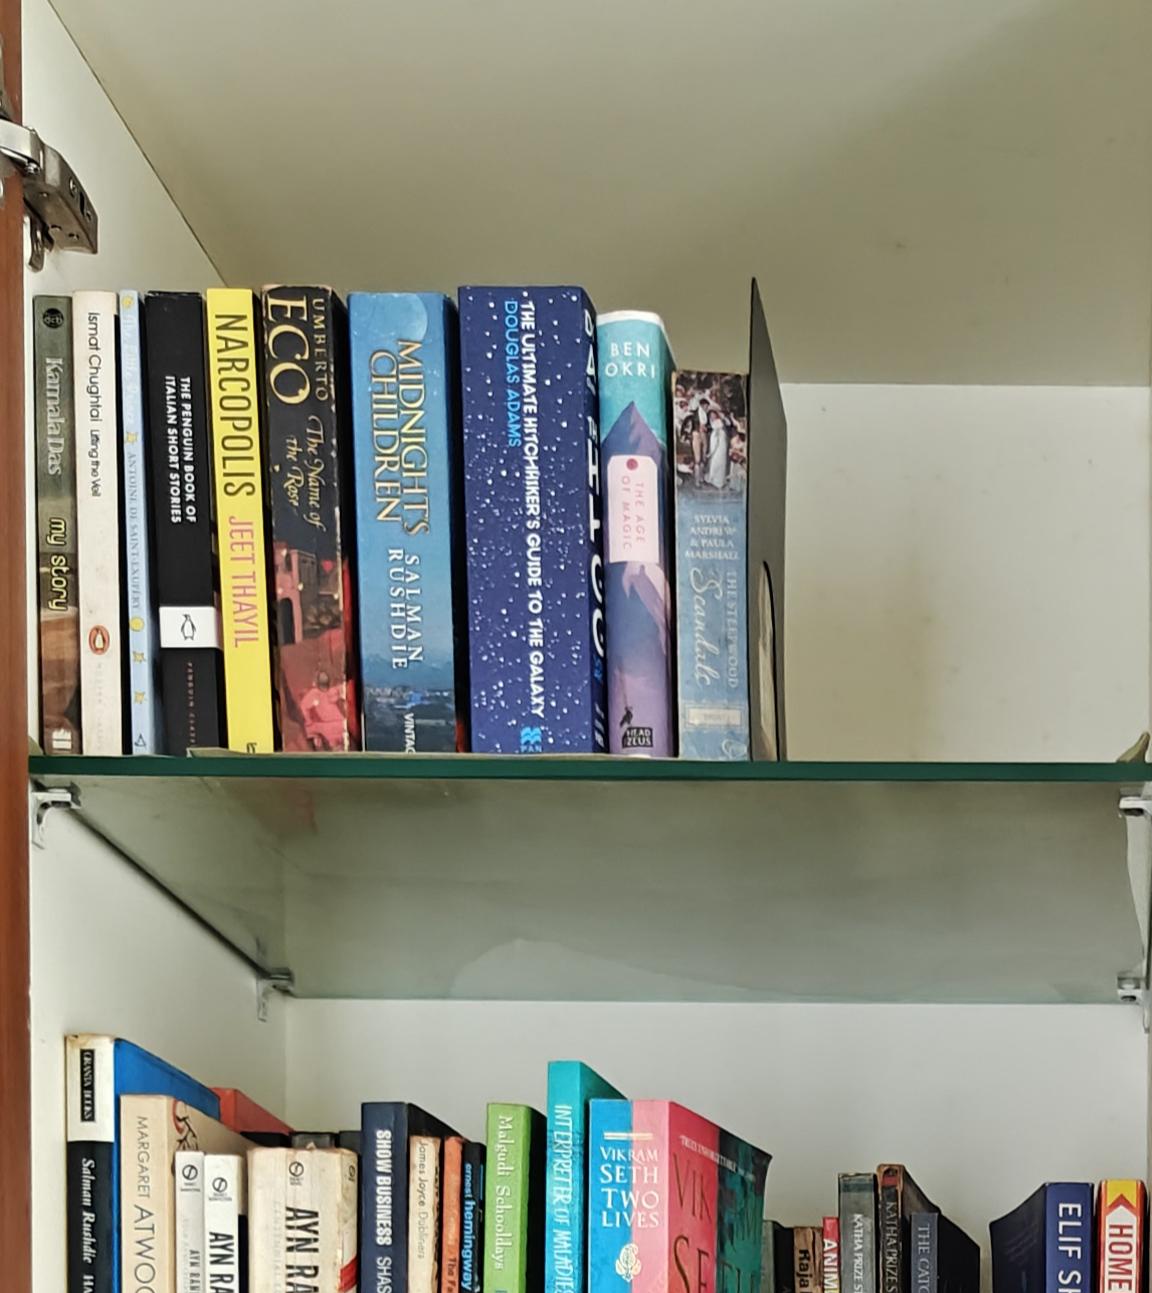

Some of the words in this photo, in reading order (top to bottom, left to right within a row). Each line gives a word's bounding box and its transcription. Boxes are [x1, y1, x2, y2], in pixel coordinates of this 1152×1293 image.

[87, 312, 102, 351] Ismat
[265, 294, 309, 404] ECO
[312, 298, 329, 401] UMBERTO
[611, 341, 650, 357] BEN
[87, 354, 103, 422] Chughtai
[605, 361, 656, 377] OKRI
[165, 376, 177, 425] ITALIAN
[215, 313, 256, 497] NARCOPOLIS
[166, 429, 179, 469] SHORT
[368, 350, 401, 522] CHILDREN
[396, 339, 429, 536] MIDNIGHT'S
[169, 473, 182, 523] STORIES
[49, 518, 67, 545] my
[228, 515, 255, 563] JEET
[50, 555, 69, 611] story
[231, 571, 259, 648] THAYIL
[136, 1116, 150, 1199] MARGARET
[285, 1207, 320, 1254] AYN
[1057, 1203, 1082, 1259] ELIF
